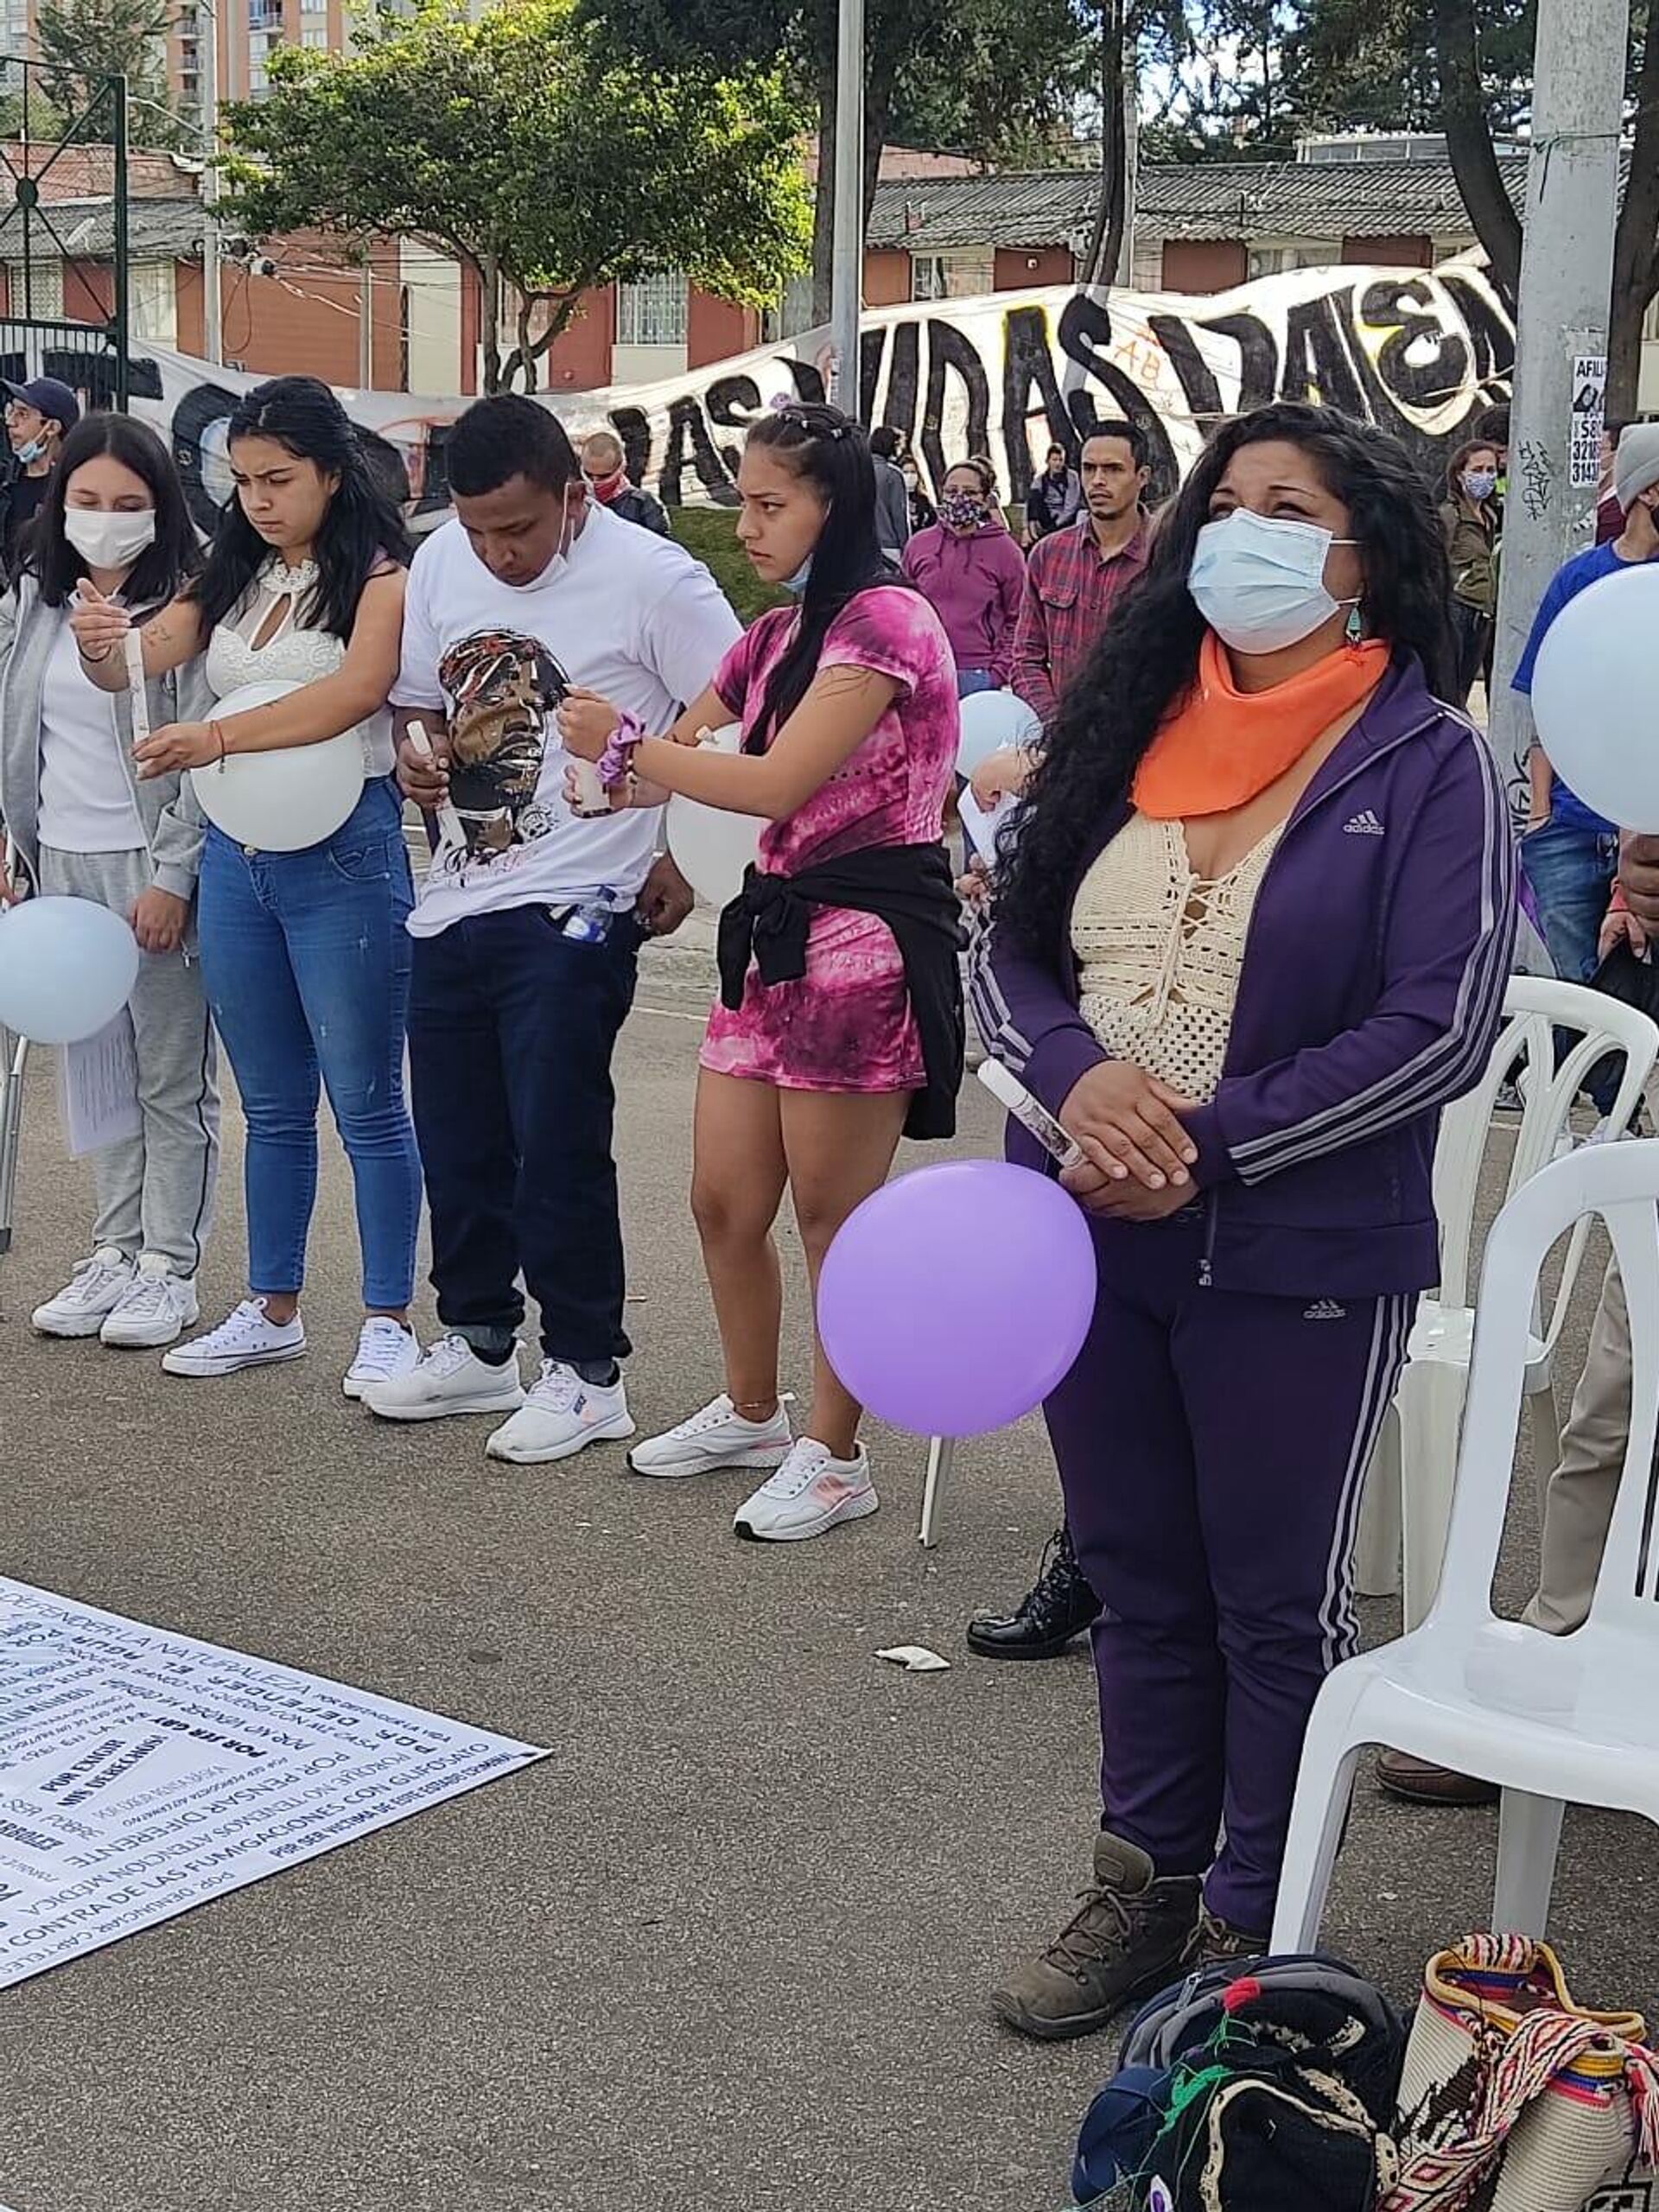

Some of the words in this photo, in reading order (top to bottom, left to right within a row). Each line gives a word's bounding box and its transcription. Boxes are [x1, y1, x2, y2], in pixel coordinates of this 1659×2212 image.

[115, 1630, 151, 1647] LA
[150, 1643, 310, 1694] NATURALEZA
[162, 1661, 194, 1675] EL
[207, 1676, 359, 1726] DEFENDER
[148, 1717, 189, 1731] GAY
[188, 1728, 226, 1742] SER
[221, 1739, 267, 1758] POR
[375, 1729, 437, 1754] POR
[295, 1751, 350, 1775] POR
[331, 1752, 410, 1785] PORQUE
[39, 1772, 80, 1792] POR
[201, 1772, 300, 1813] PENSAR
[302, 1783, 338, 1799] NO
[213, 1797, 307, 1837] TENEMOS
[9, 1904, 111, 1946] CONTRA
[105, 1885, 145, 1904] DE
[140, 1869, 187, 1888] LAS
[184, 1803, 345, 1871] FUMIGACIONES
[342, 1783, 391, 1804] CON
[389, 1743, 488, 1785] GLIFOSATO
[63, 1811, 207, 1867] DIFERENTE
[192, 1871, 235, 1889] POR
[92, 1888, 195, 1932] DENUNCIAR
